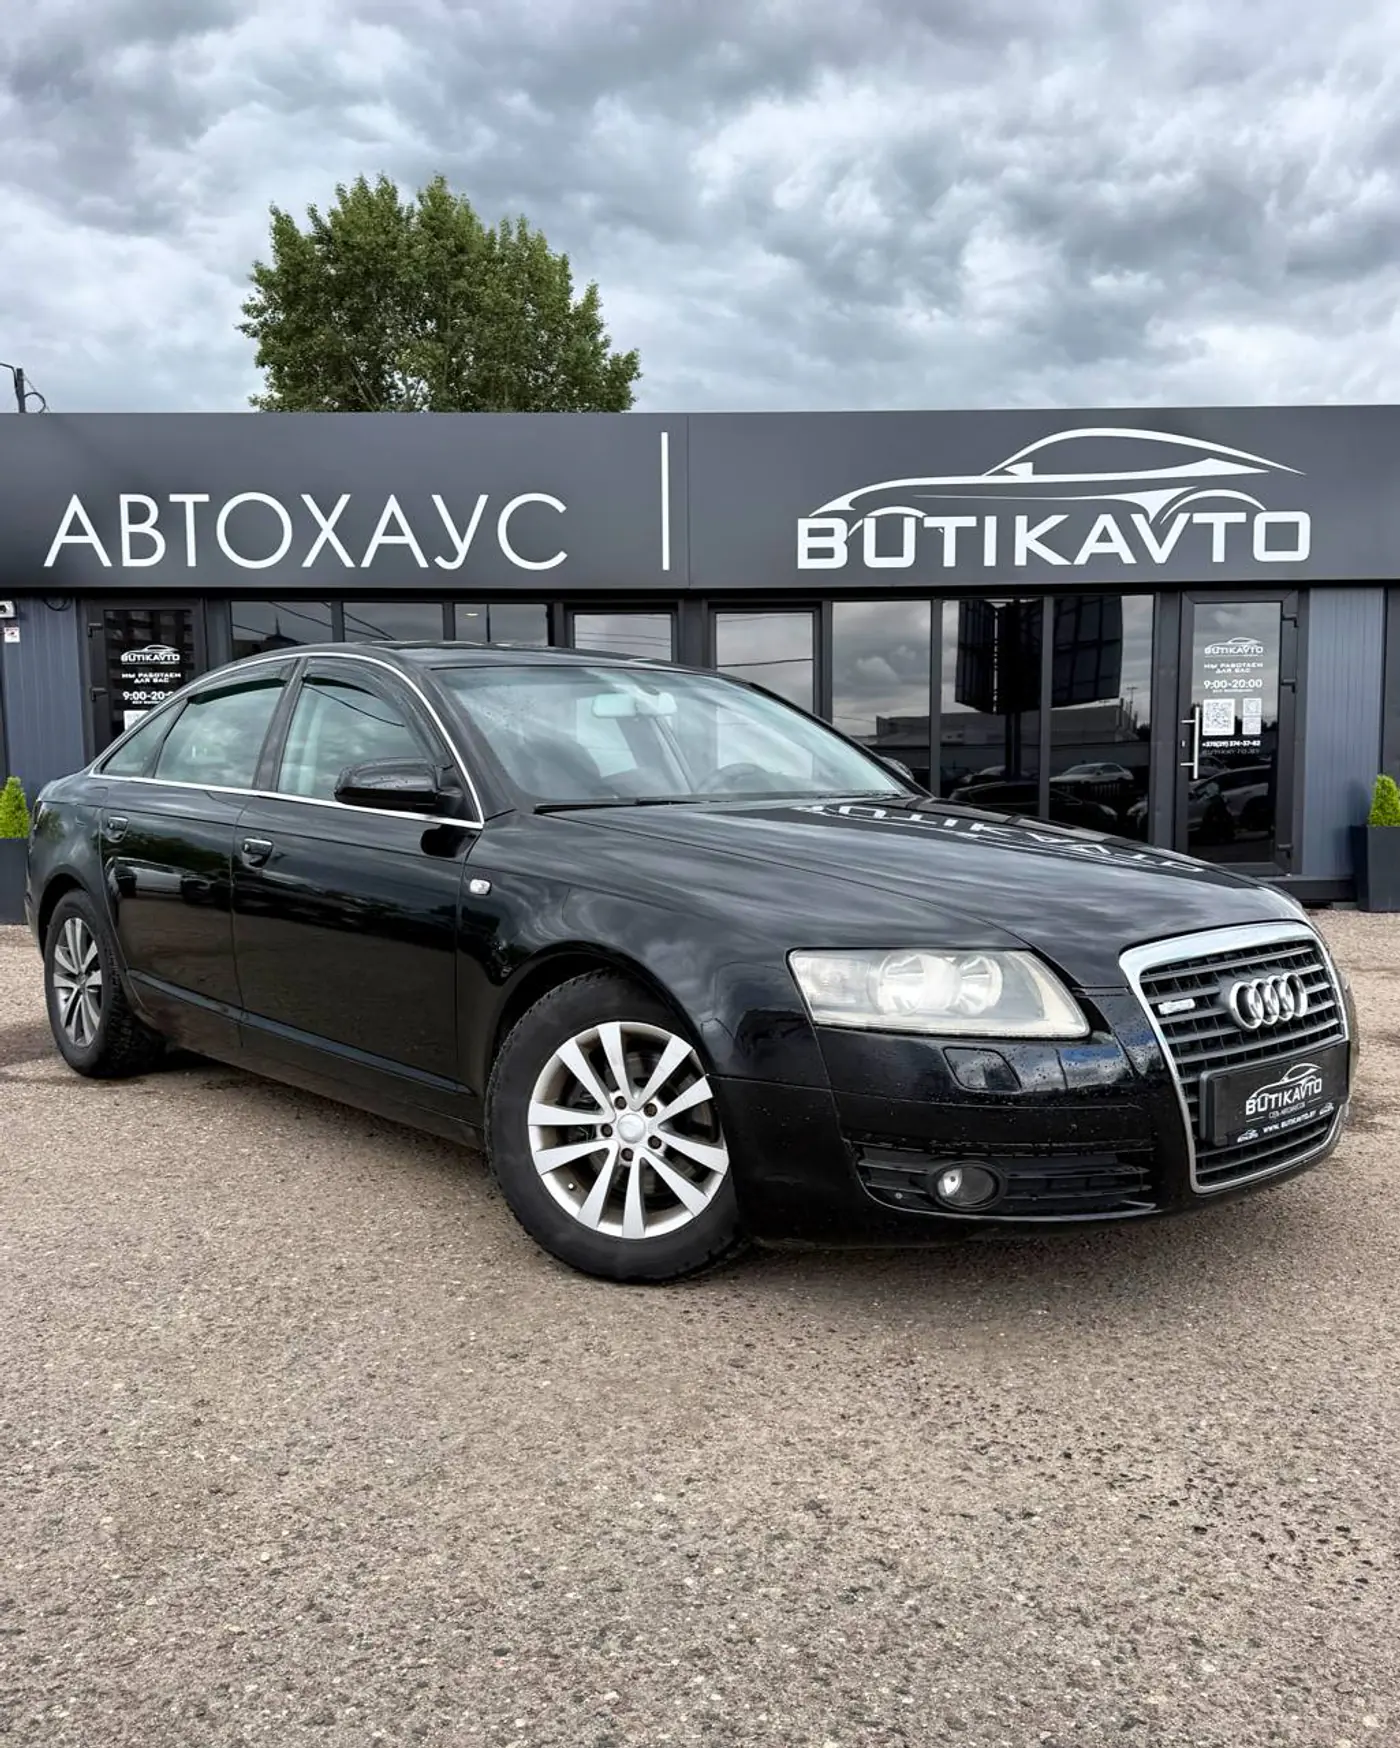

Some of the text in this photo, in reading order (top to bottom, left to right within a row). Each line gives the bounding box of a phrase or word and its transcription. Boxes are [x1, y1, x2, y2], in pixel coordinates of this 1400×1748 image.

[43, 491, 568, 571] АВТОХАУС
[797, 510, 1311, 569] BUTIKAVTO
[1204, 645, 1264, 655] BUTIKAVTO
[120, 653, 181, 662] BUTIKAVTO
[1203, 679, 1264, 689] 9:00-20:00
[122, 691, 175, 701] 9:00-20:
[1245, 1077, 1322, 1116] BUTIKAVTO
